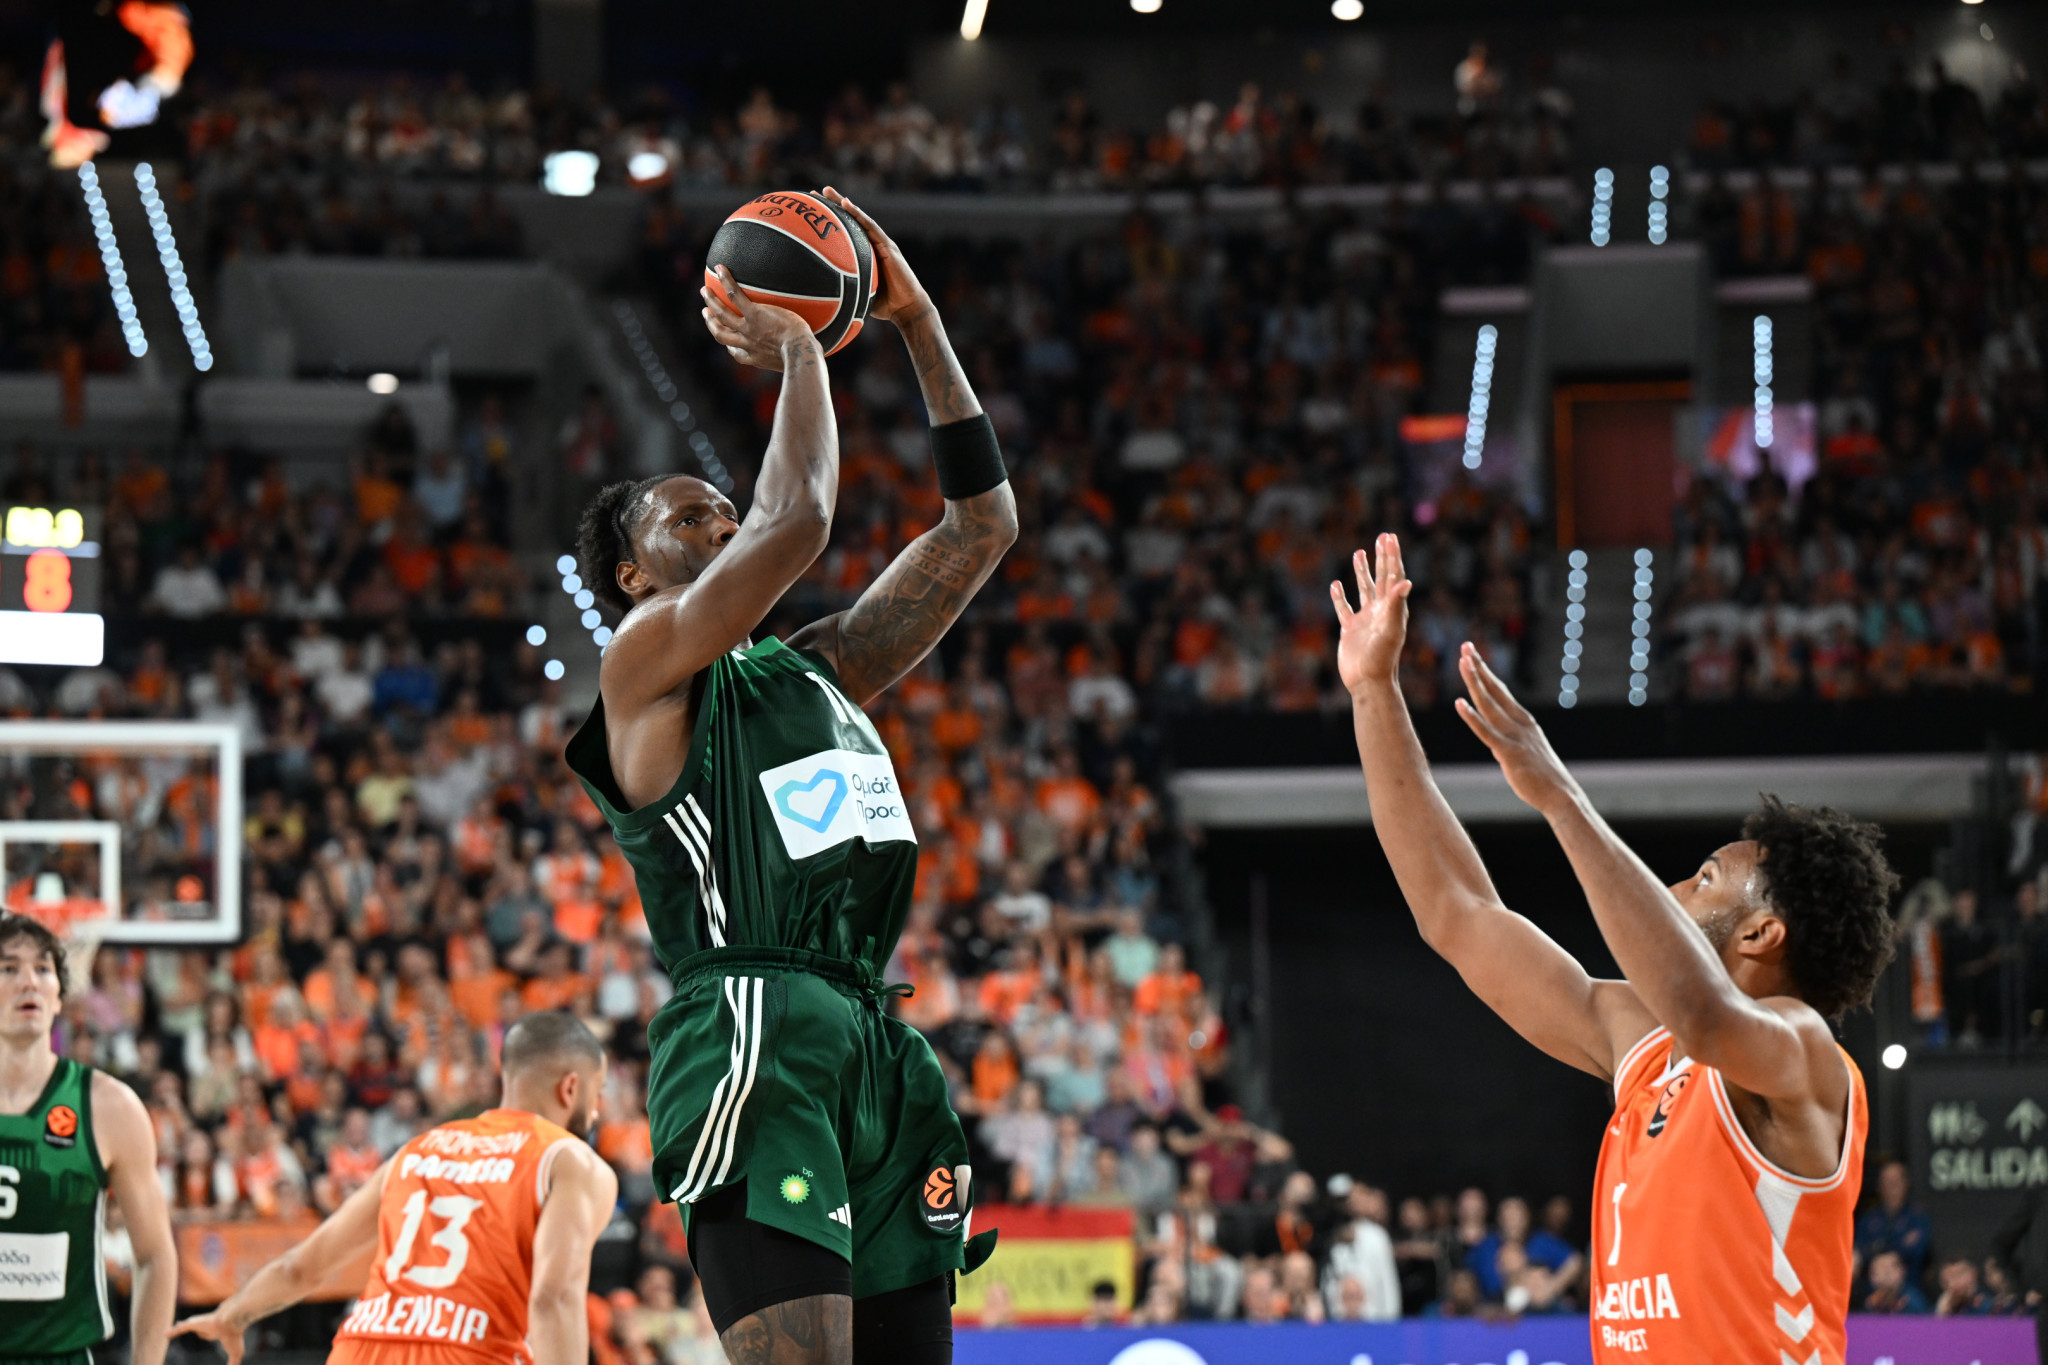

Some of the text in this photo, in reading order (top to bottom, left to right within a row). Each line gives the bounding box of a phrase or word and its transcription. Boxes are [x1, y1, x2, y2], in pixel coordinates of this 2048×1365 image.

[745, 194, 840, 240] SPALDIN
[852, 773, 897, 798] Ομάδ
[802, 1166, 814, 1178] bp
[385, 1189, 484, 1289] 13
[343, 1291, 490, 1344] VALENCIA
